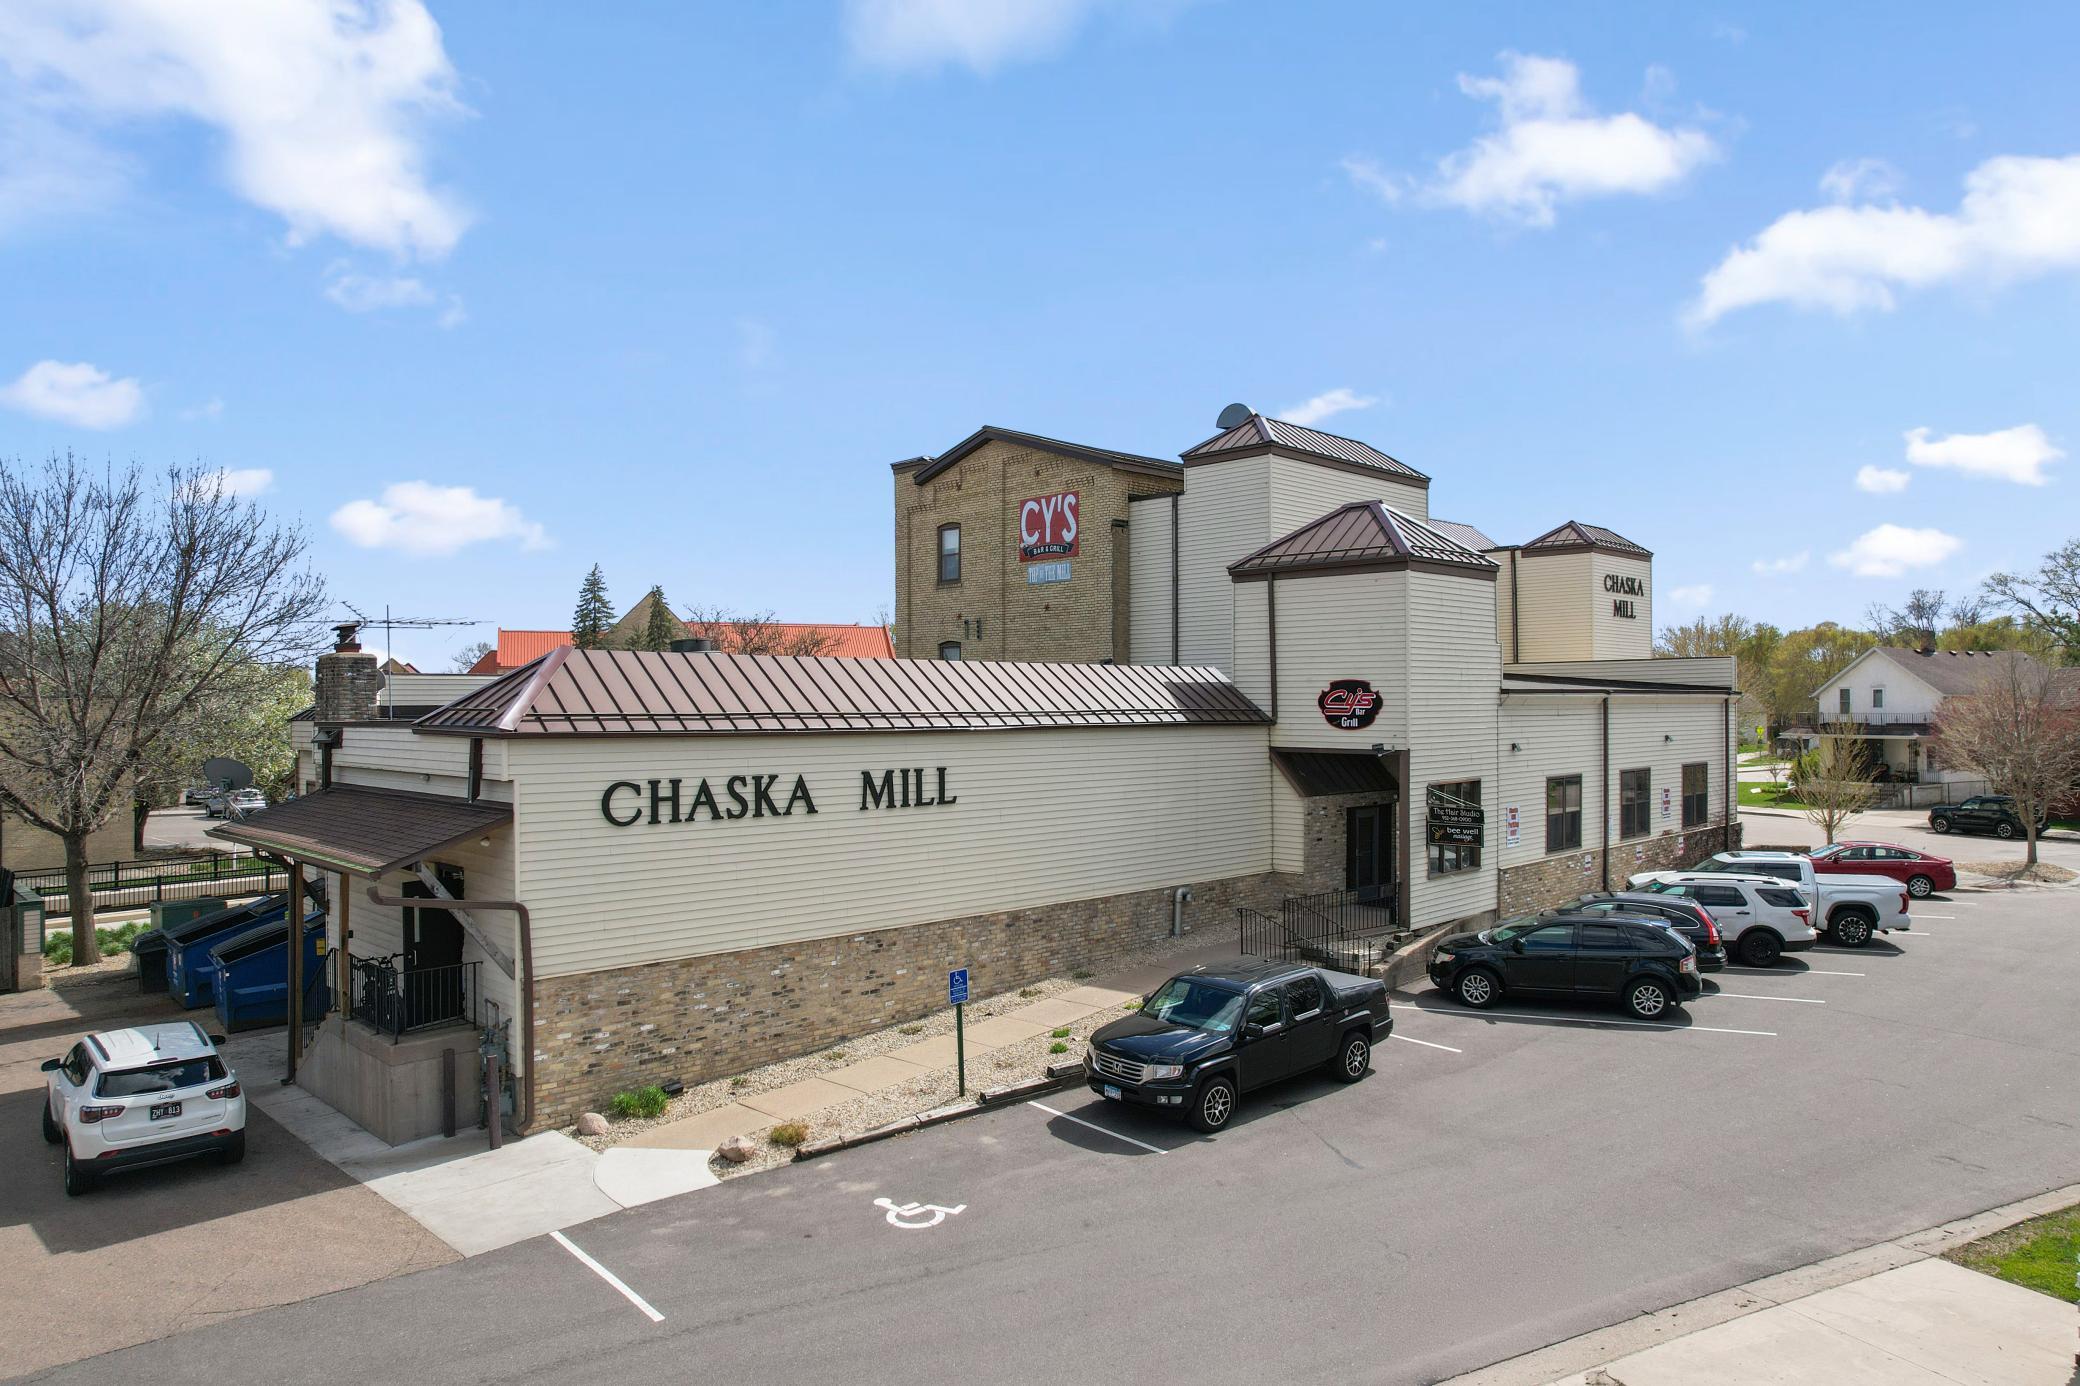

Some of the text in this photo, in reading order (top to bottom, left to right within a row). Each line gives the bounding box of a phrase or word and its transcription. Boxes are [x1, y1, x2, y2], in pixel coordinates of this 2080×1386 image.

[1020, 494, 1077, 545] CY'S
[1033, 546, 1045, 555] BAR
[1603, 574, 1644, 597] CHASKA
[1613, 599, 1637, 619] MILL
[1341, 717, 1359, 727] Grill
[601, 767, 957, 827] CHASKA MILL
[1433, 807, 1481, 818] The Hair Studio
[1446, 826, 1461, 834] bee
